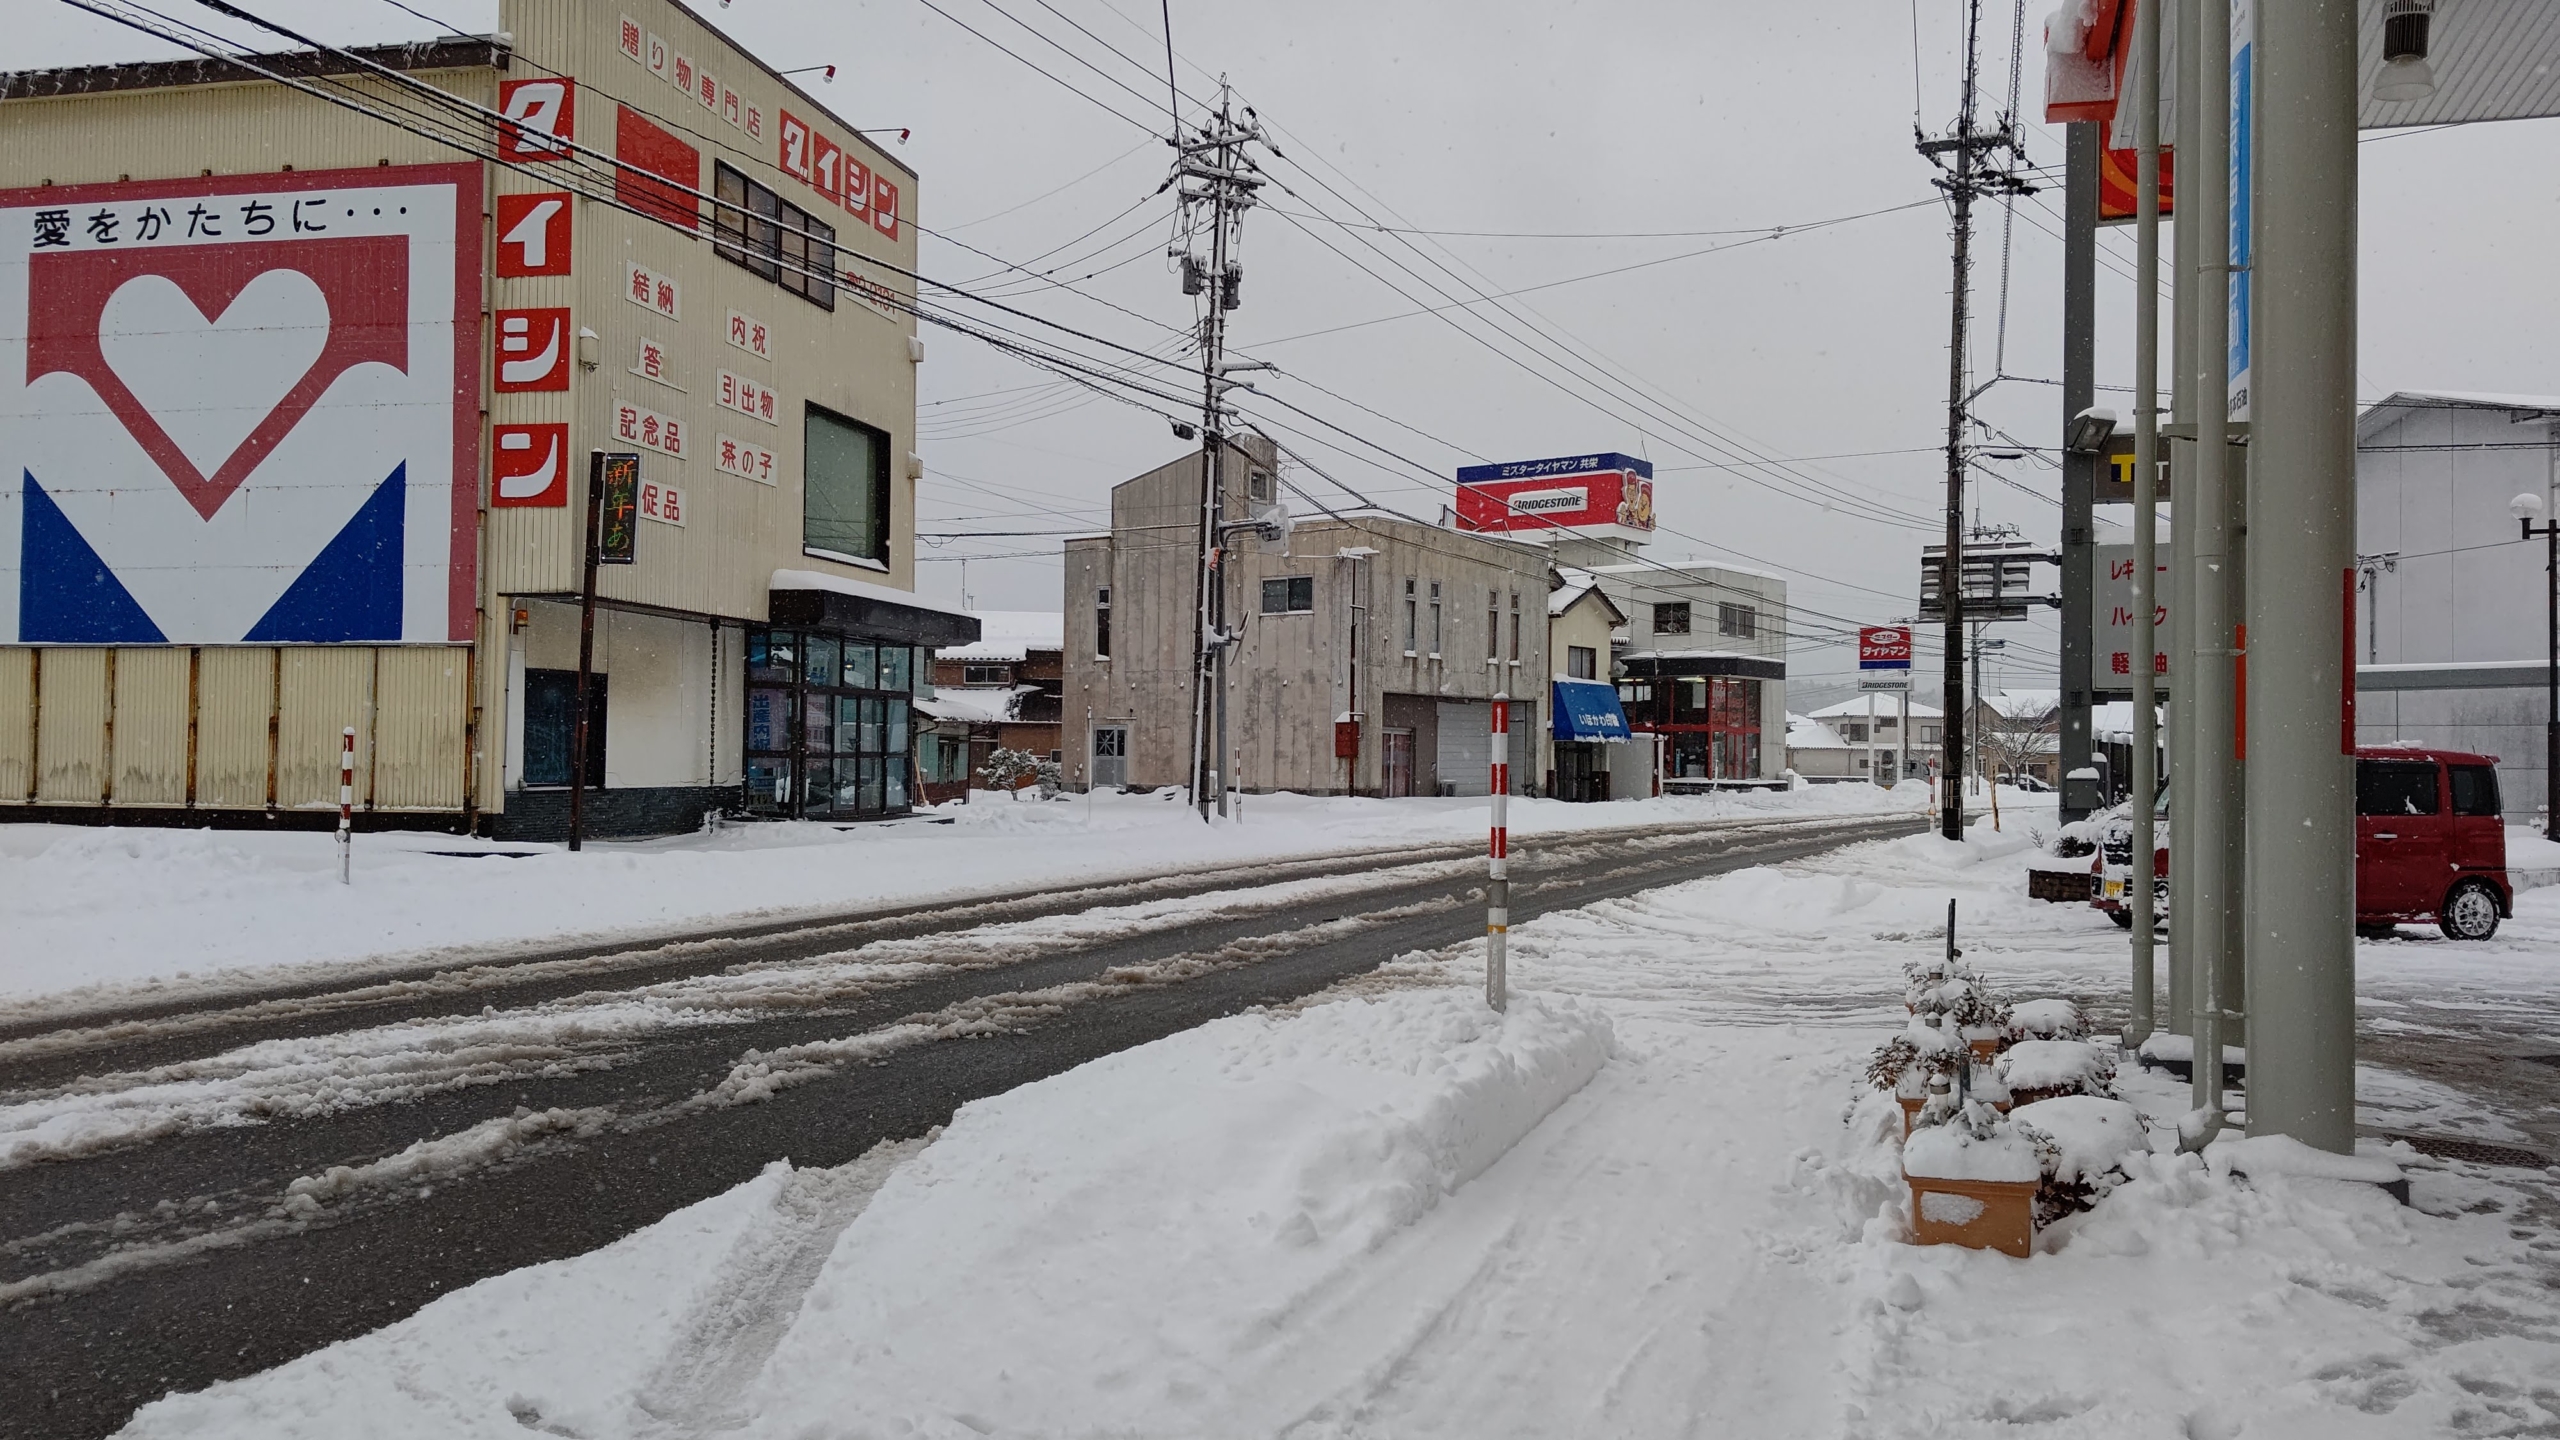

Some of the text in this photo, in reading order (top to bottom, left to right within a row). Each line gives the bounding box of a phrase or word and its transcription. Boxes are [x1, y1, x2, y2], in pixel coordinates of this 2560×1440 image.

[621, 19, 762, 138] 贈り物専門店
[632, 267, 675, 315] 結納
[731, 314, 766, 356] 内祝
[643, 344, 662, 378] 答
[722, 374, 774, 420] 引出物
[619, 406, 682, 454] 記念品
[721, 439, 773, 480] 茶の子
[1502, 457, 1599, 477] ミスタータイヤマン 共栄
[606, 460, 637, 551] 新年あ
[641, 483, 681, 523] 促品
[1512, 496, 1582, 511] BRIDGESTONE
[2110, 560, 2168, 580] レギー
[1862, 646, 1908, 657] タイヤマン
[1861, 681, 1908, 689] BRIDGESTONE
